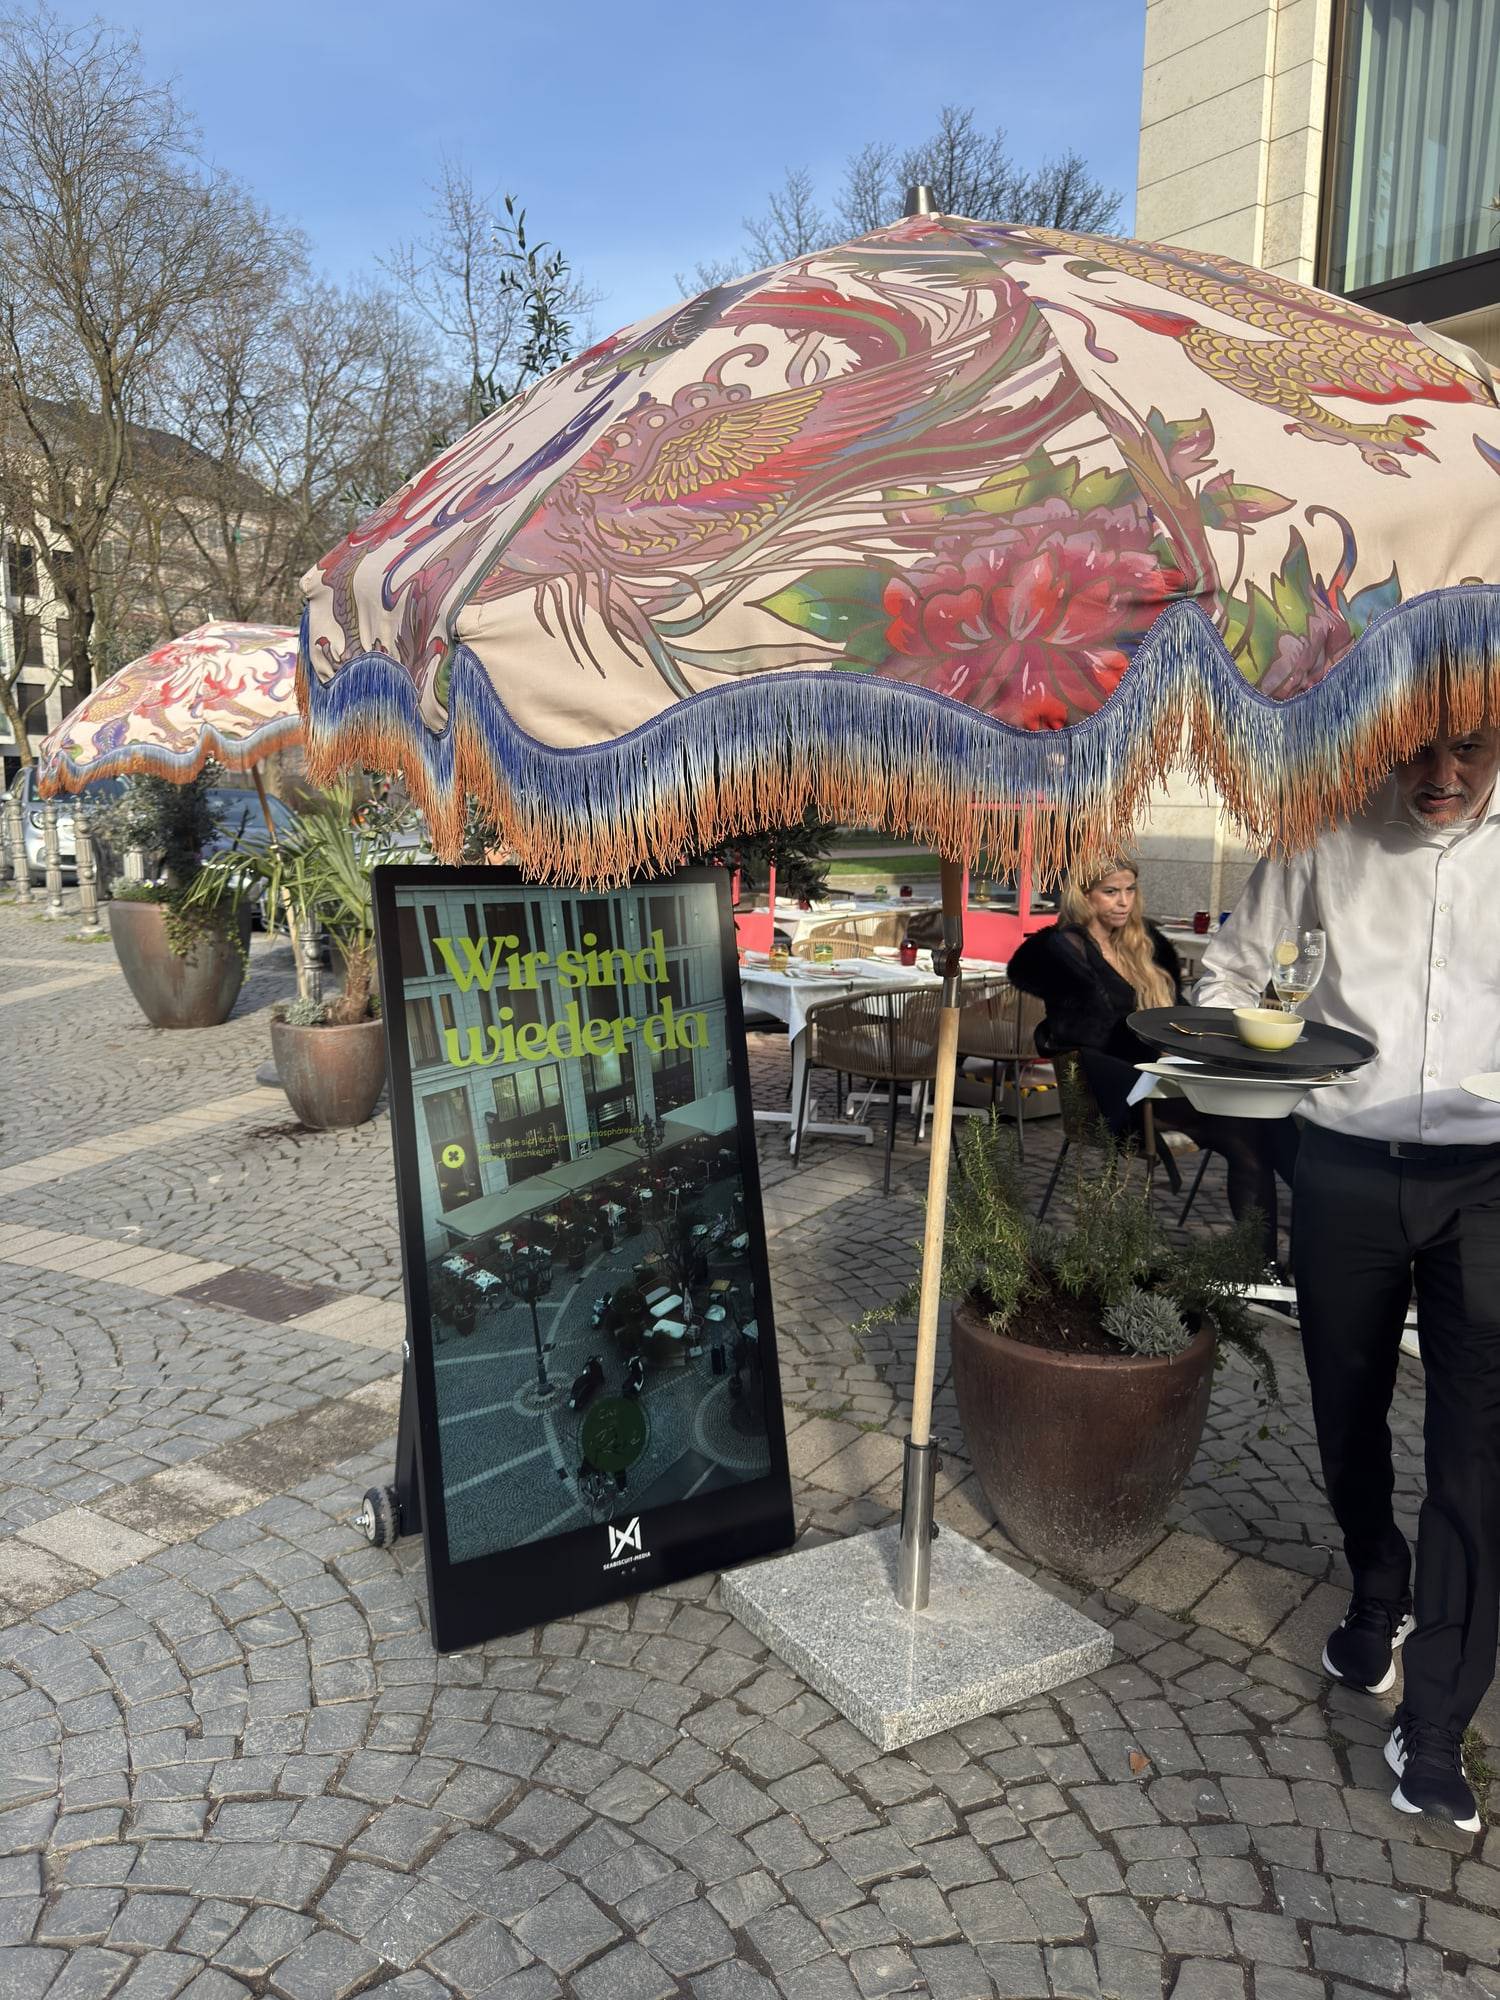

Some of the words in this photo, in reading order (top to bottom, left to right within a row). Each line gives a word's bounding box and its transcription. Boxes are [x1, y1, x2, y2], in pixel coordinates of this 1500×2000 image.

[432, 934, 550, 992] Wir
[556, 929, 670, 988] sind
[444, 1001, 637, 1067] wieder
[643, 996, 709, 1054] da
